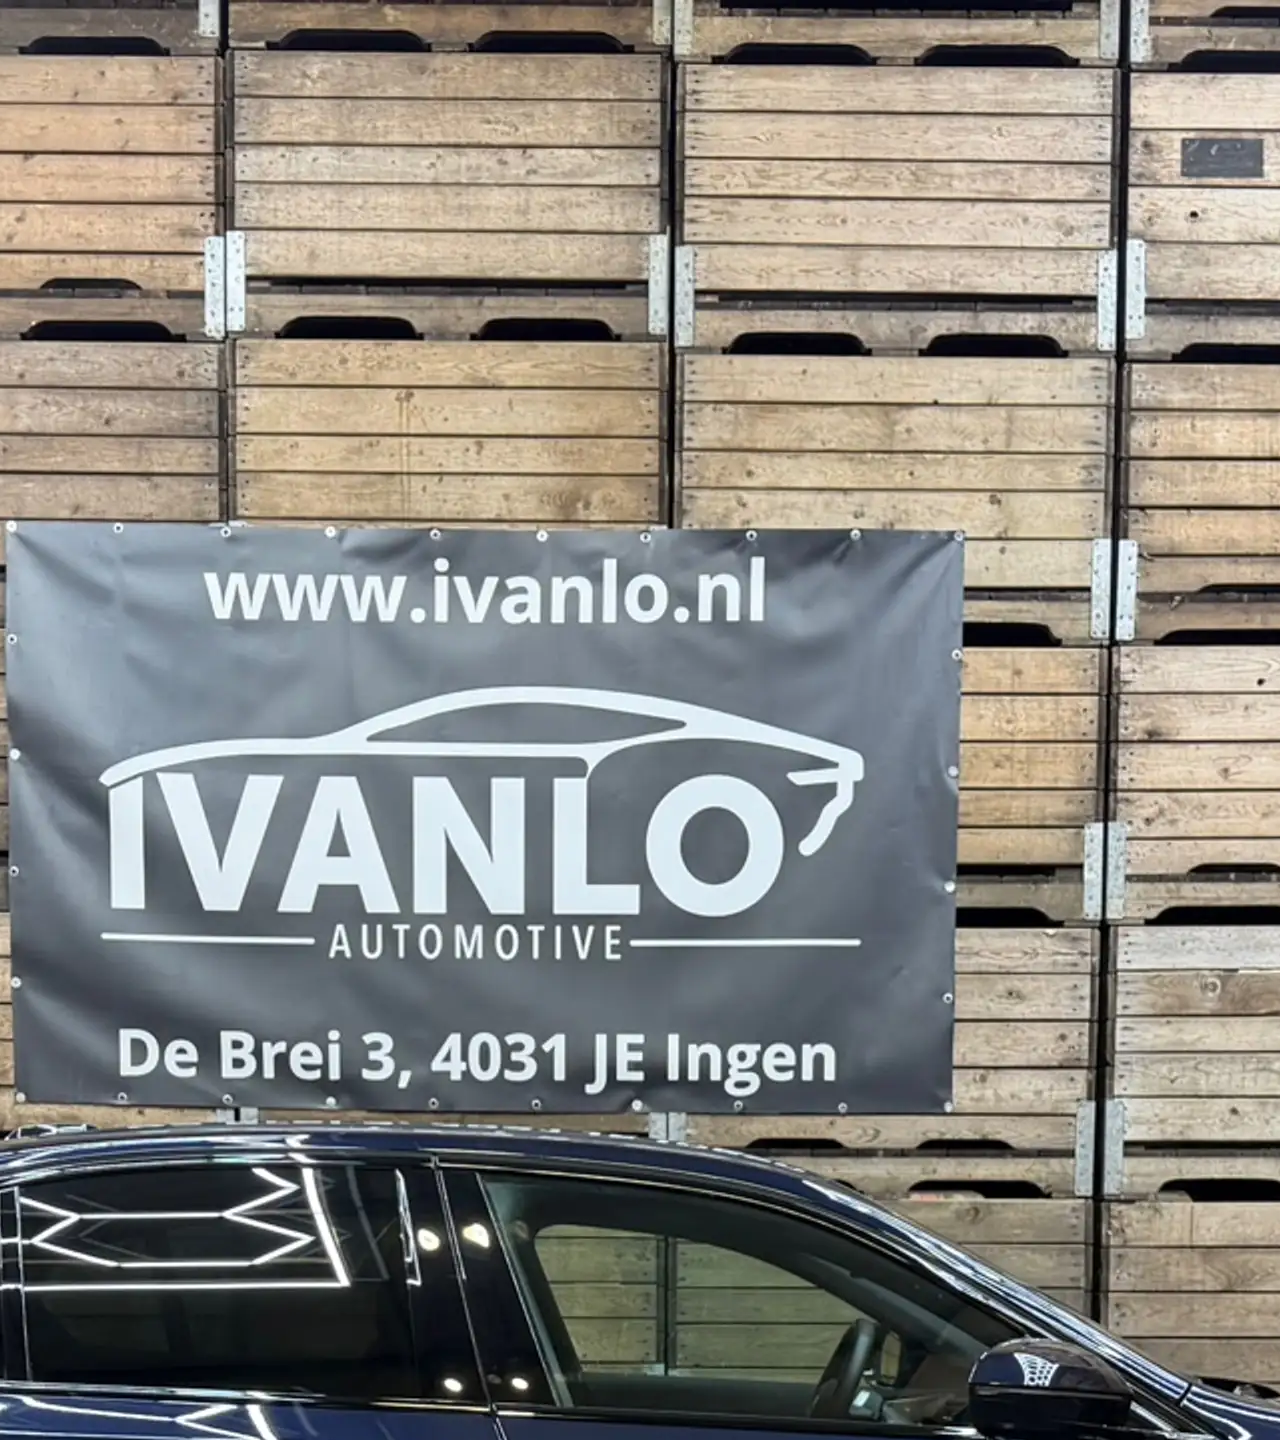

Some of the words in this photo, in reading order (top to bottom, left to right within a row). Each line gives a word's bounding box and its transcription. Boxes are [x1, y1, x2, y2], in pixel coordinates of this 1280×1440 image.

[203, 557, 766, 625] www.ivanlo.nl
[110, 771, 785, 918] IVANLO
[329, 922, 623, 961] AUTOMOTIVE
[120, 1028, 199, 1078] De
[220, 1029, 342, 1081] Brei
[361, 1032, 412, 1089] 3,
[430, 1032, 567, 1082] 4031
[585, 1033, 645, 1094] JE
[666, 1033, 837, 1097] Ingen
